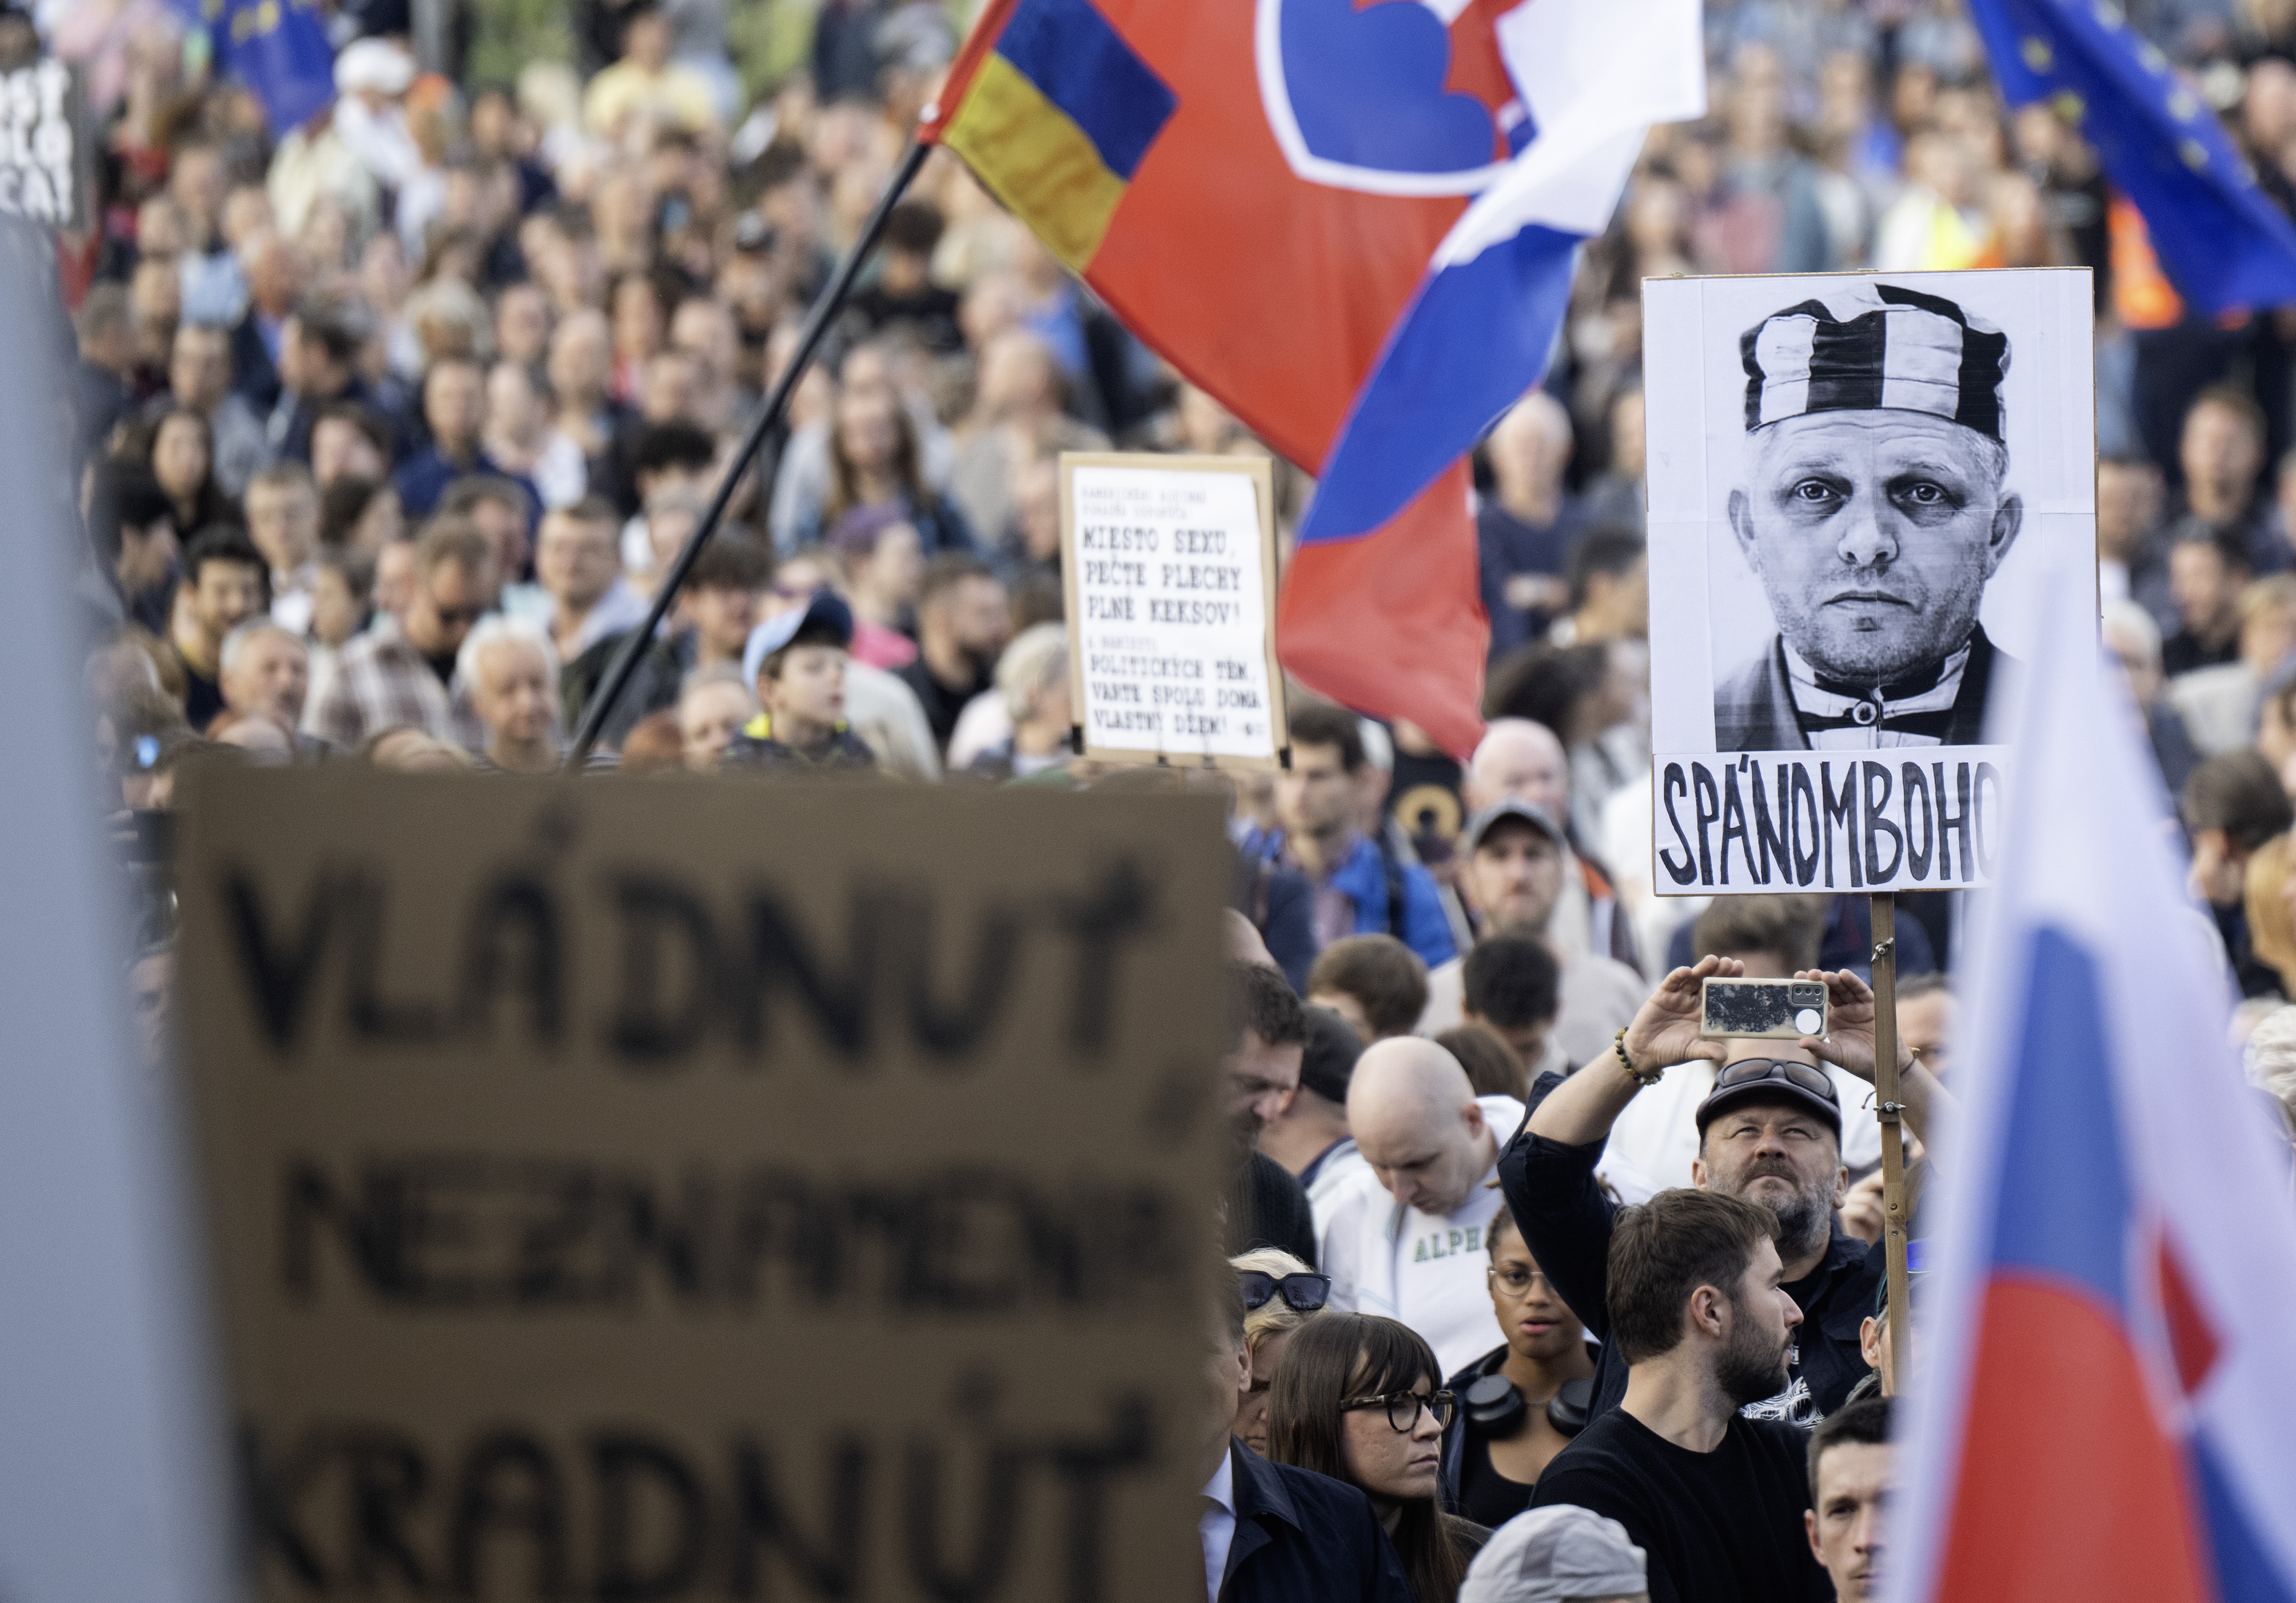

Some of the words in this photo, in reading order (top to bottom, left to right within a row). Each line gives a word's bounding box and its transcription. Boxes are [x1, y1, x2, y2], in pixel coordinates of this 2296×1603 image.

[1083, 525, 1159, 552] MIESTO
[1174, 528, 1236, 561] SEXU,
[1085, 555, 1146, 588] PEČTE
[1162, 562, 1242, 592] PLECHY
[1087, 591, 1135, 621] PLNÉ
[1149, 597, 1241, 628] KEKSOV!
[1090, 652, 1205, 679] POLITICKÝCH
[1153, 684, 1205, 708] SPOLU
[1217, 688, 1262, 709] DOMA
[1659, 753, 2004, 888] SPÁNOMBOHO
[1414, 1226, 1481, 1262] ALPH
